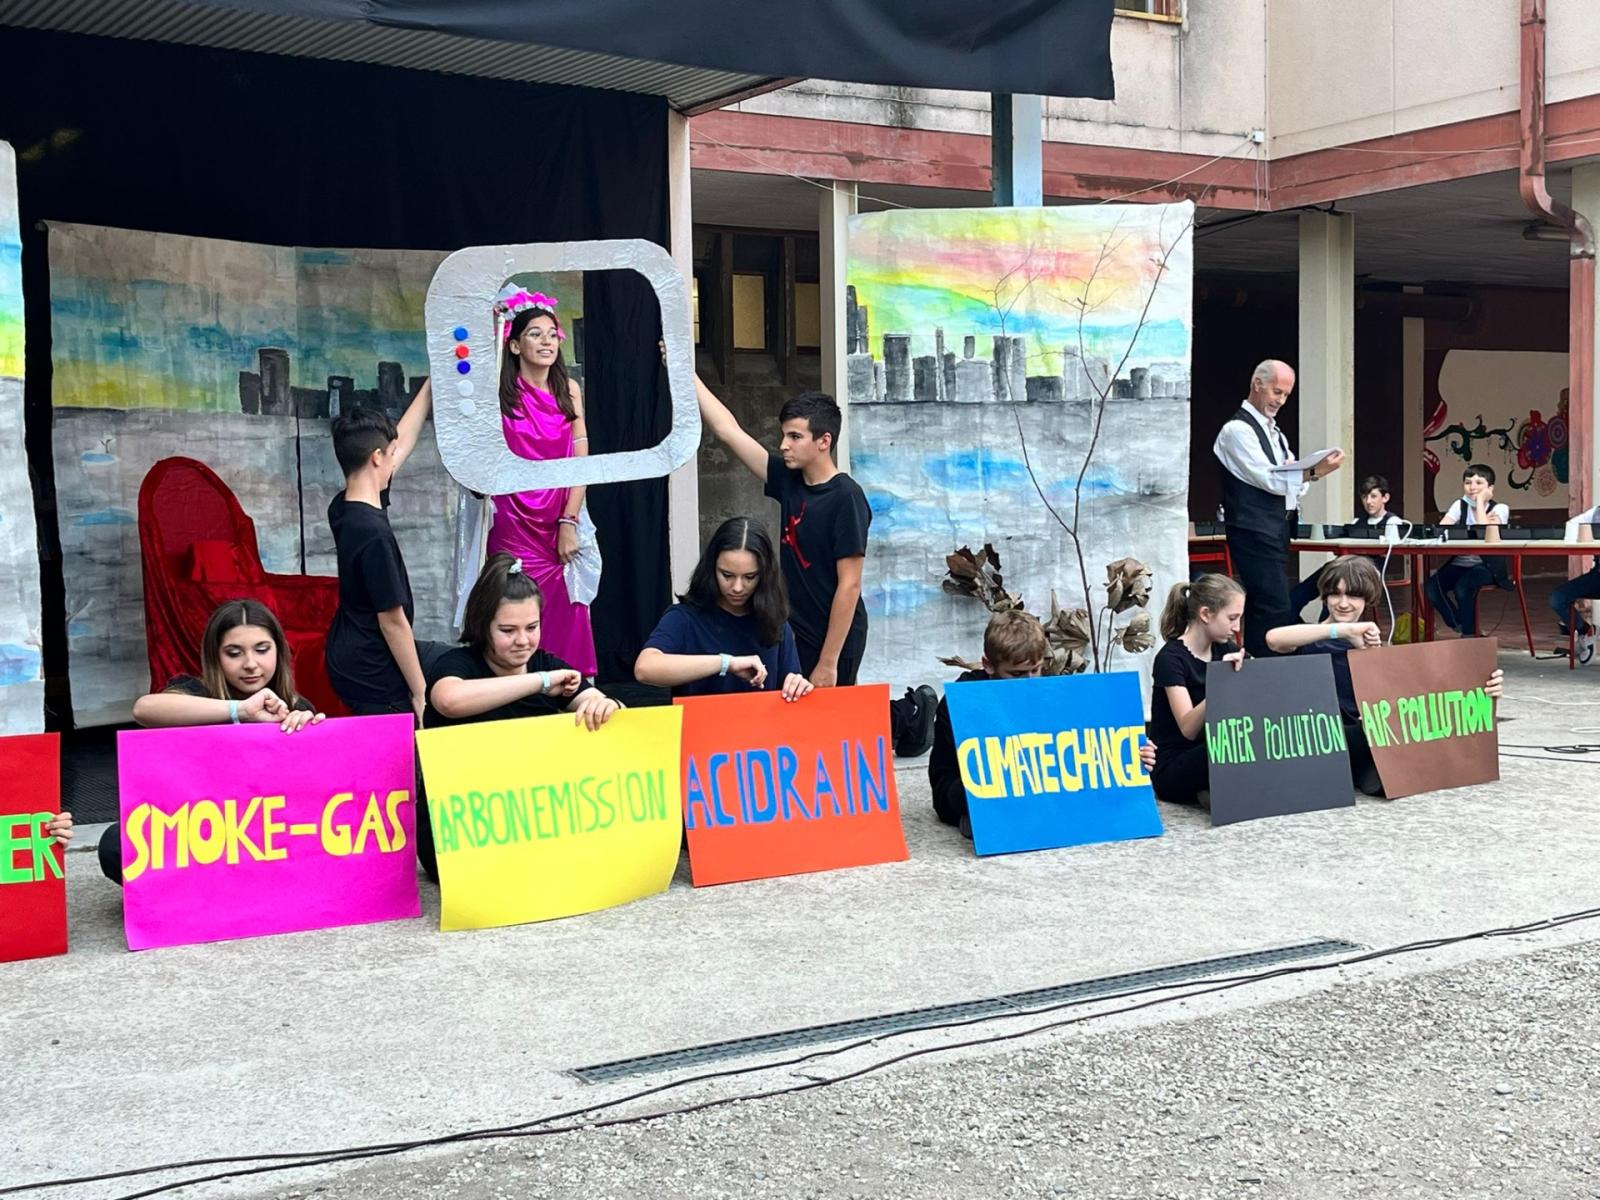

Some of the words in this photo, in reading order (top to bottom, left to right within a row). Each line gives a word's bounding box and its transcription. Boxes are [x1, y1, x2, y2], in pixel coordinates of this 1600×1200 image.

[1205, 716, 1256, 764] WATER
[1362, 699, 1400, 747] AIR
[1397, 687, 1493, 744] POLLUTION
[123, 790, 410, 882] SMOKE-GAS
